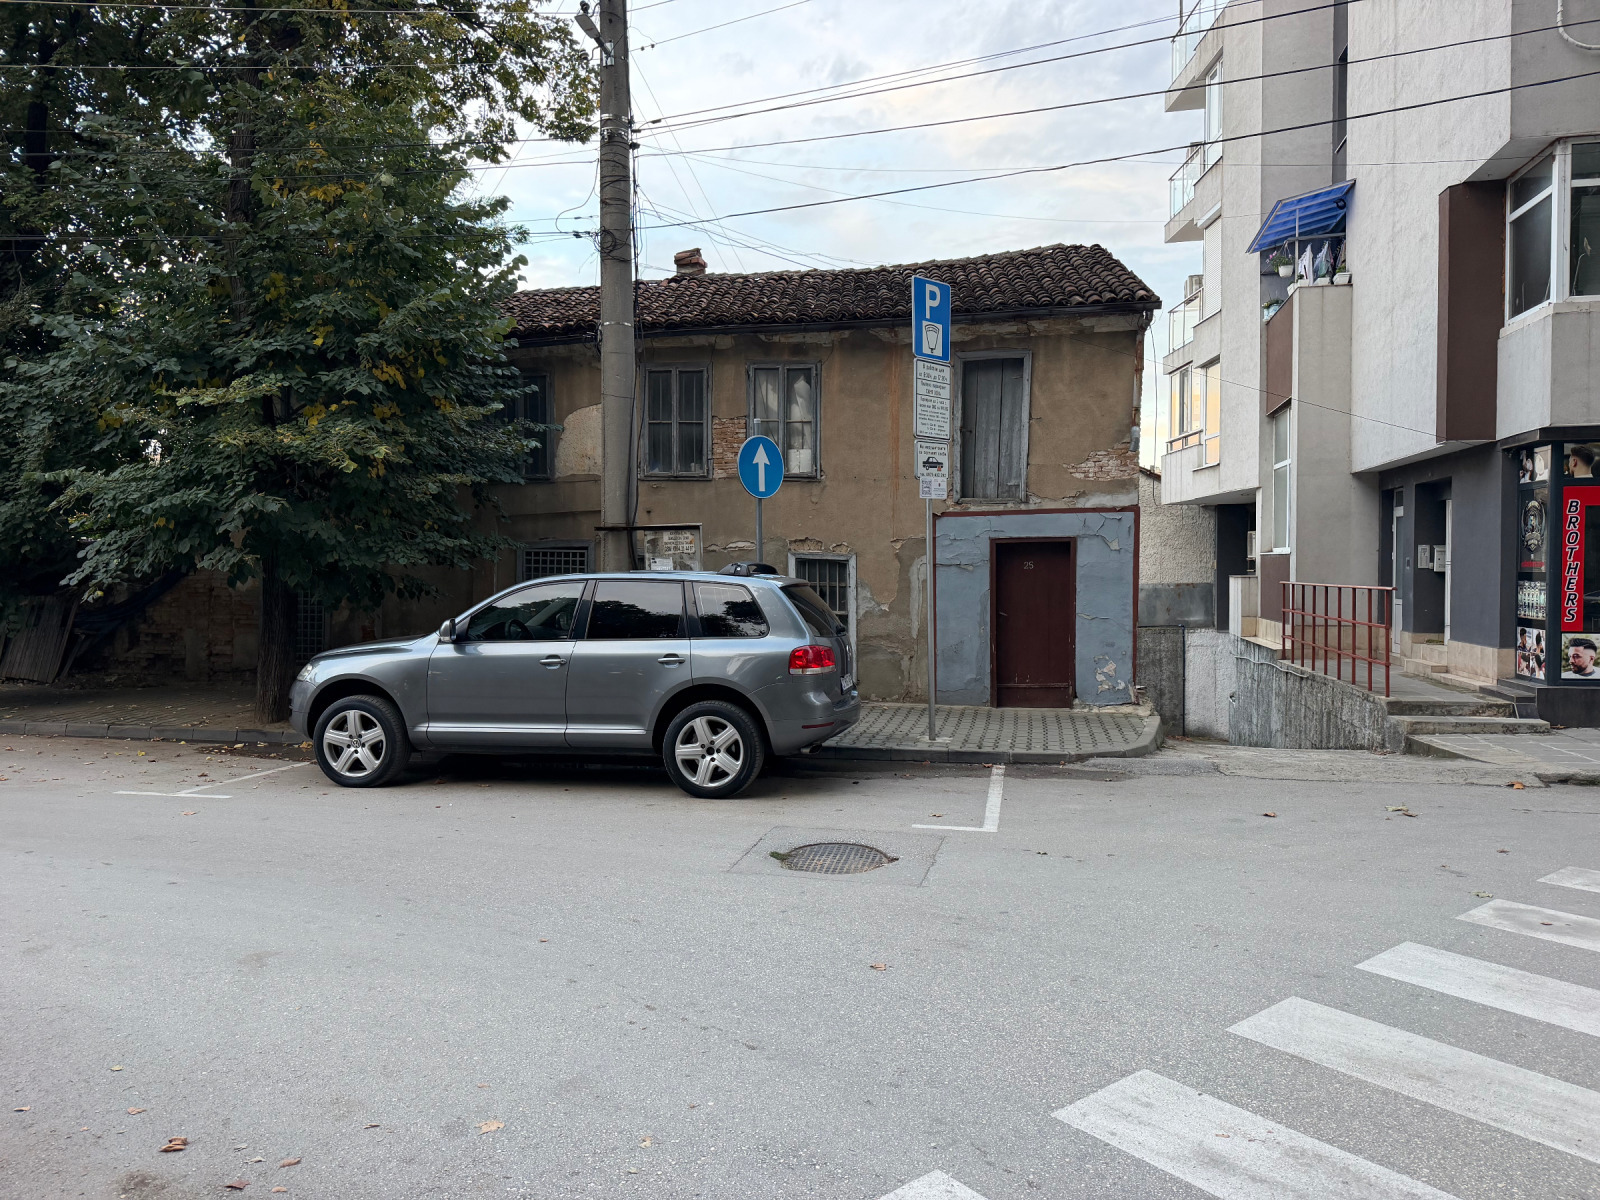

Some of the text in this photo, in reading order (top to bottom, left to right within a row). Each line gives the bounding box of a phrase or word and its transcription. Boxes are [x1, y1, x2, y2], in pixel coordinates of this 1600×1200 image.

[926, 283, 940, 319] P
[1023, 561, 1034, 570] 25
[1564, 499, 1580, 622] BROTHERS
